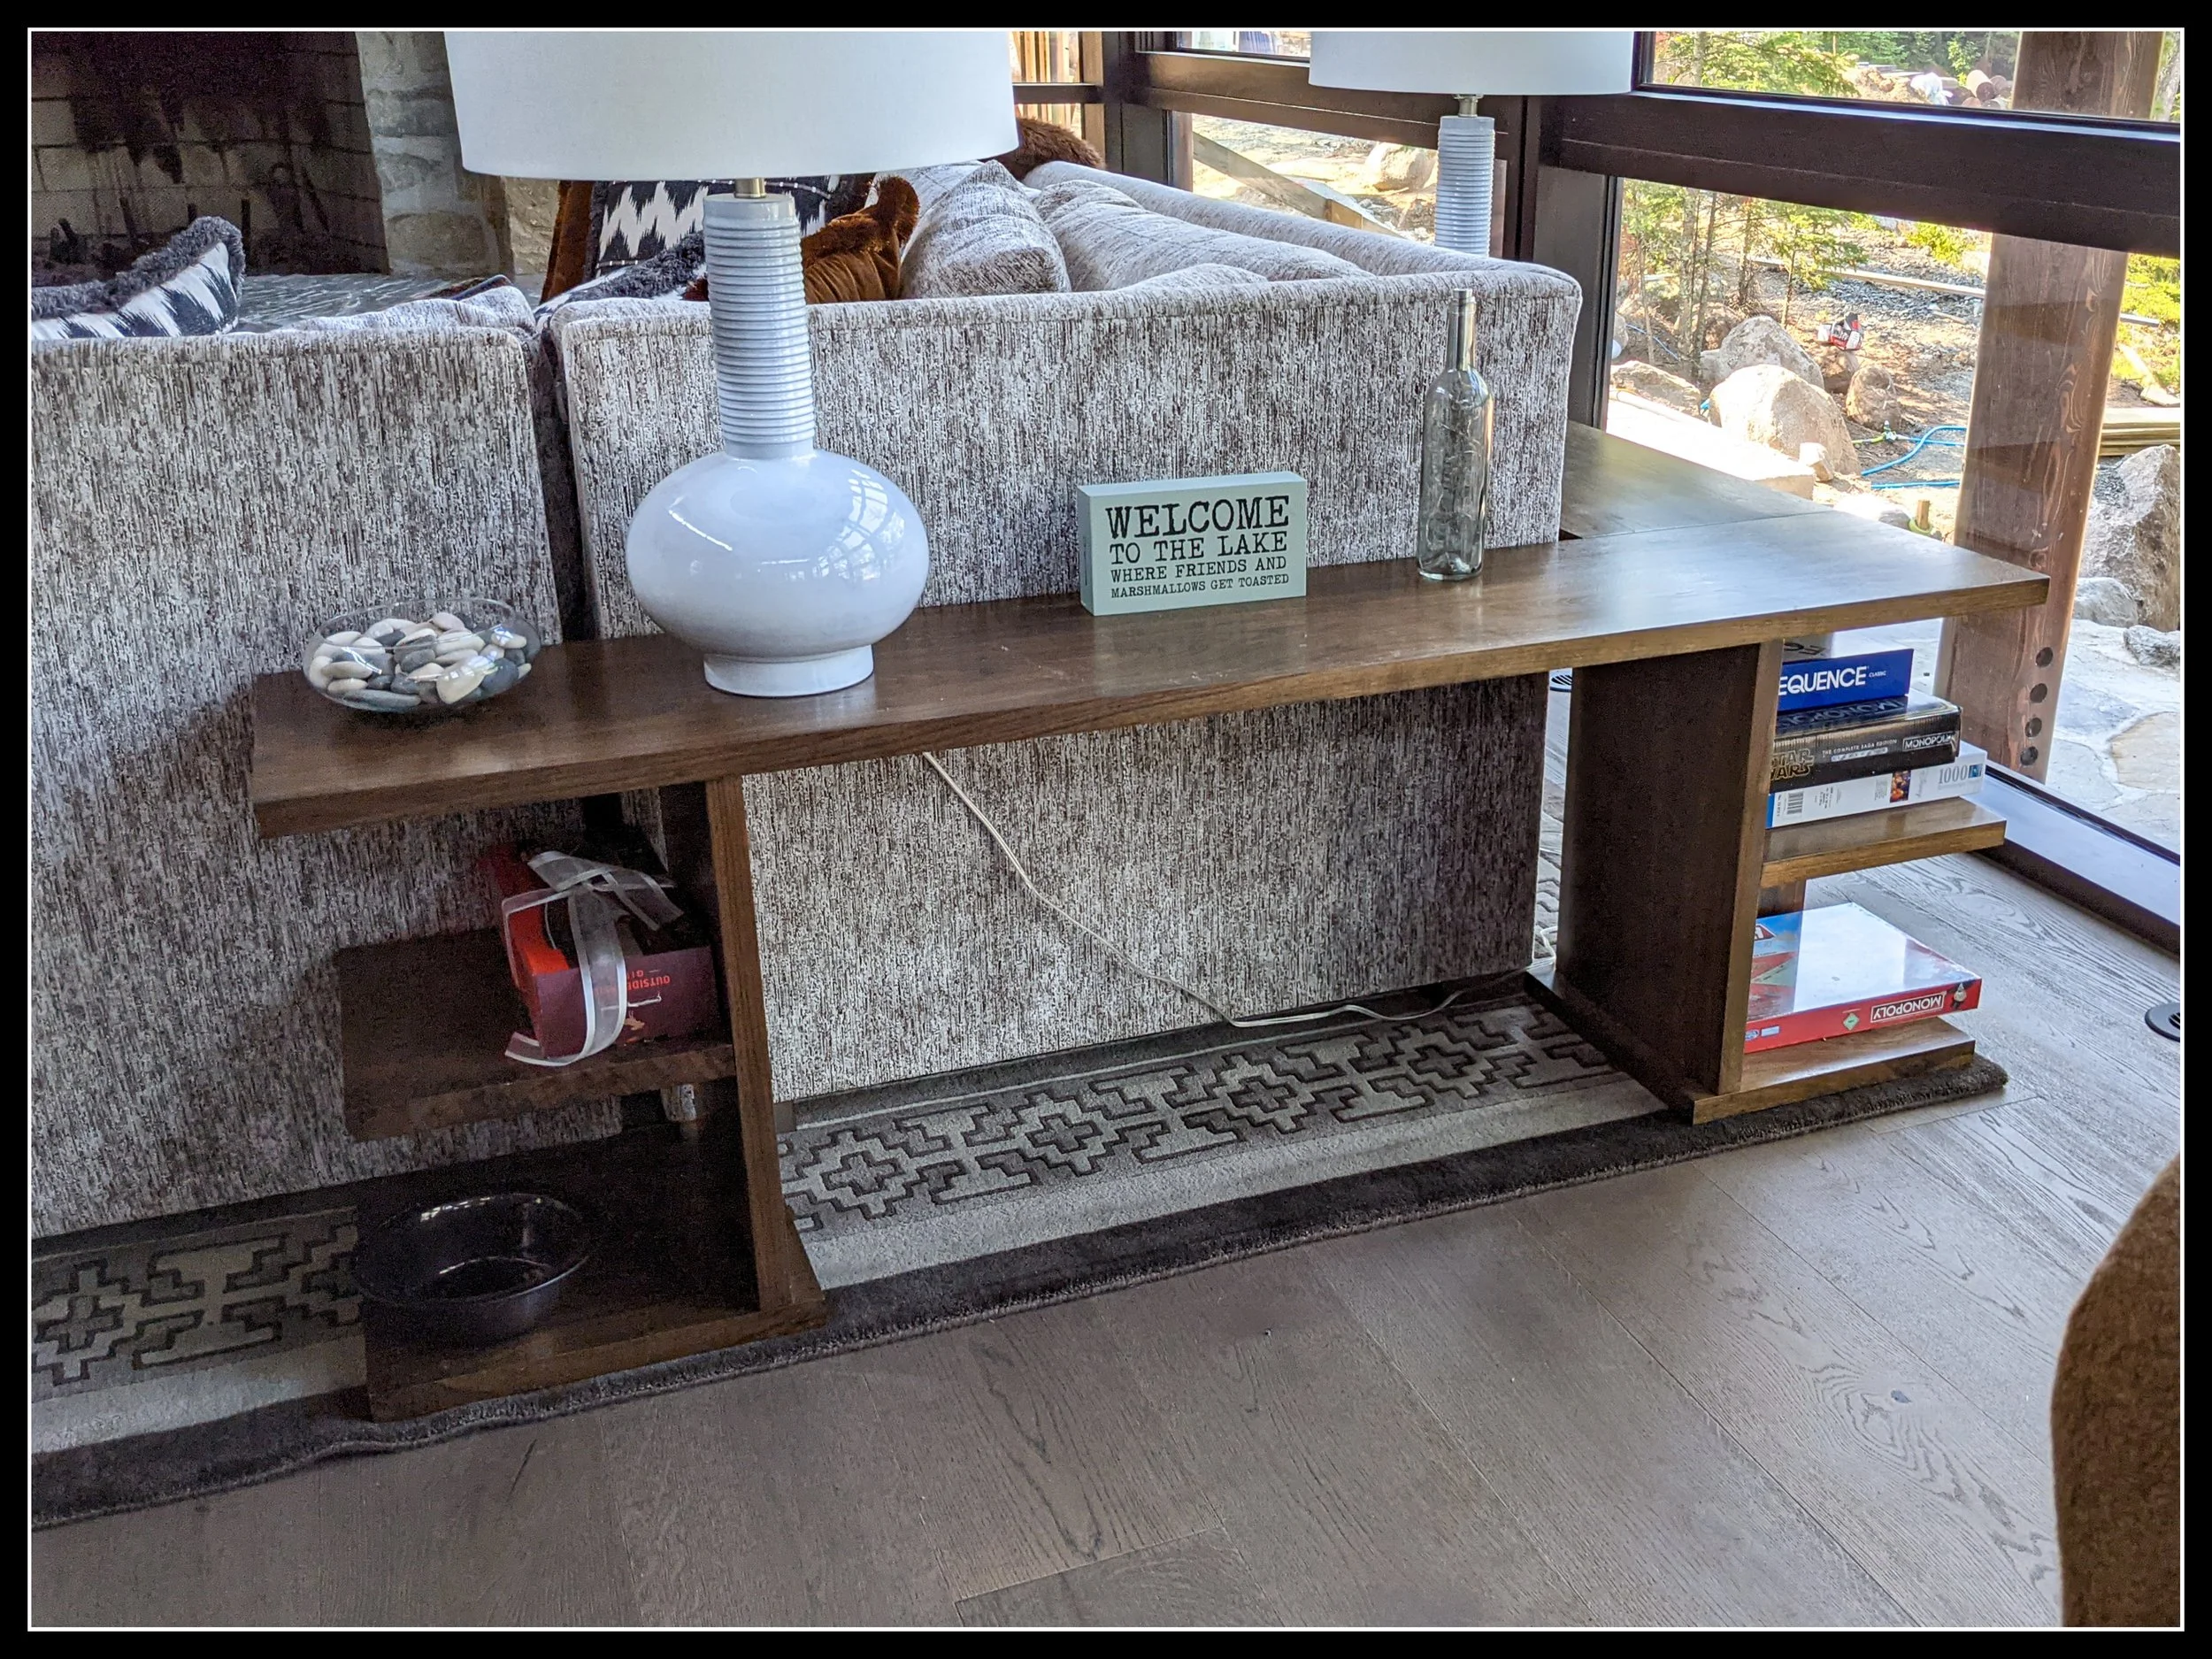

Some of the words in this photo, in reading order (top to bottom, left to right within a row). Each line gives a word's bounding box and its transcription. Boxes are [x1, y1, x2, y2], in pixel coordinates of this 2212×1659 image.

[1105, 495, 1290, 540] WELCOME
[1110, 541, 1141, 565] TO
[1154, 537, 1205, 562] THE
[1217, 531, 1288, 557] LAKE
[1110, 565, 1168, 583] WHERE
[1175, 559, 1247, 579] FRIENDS
[1255, 556, 1286, 572] AND
[1111, 580, 1206, 599] MARSHMALLOWS
[1210, 579, 1233, 590] GET
[1239, 573, 1290, 588] TOASTED
[1778, 665, 1867, 696] EQUENCE
[1833, 744, 1860, 754] COMPLETE
[1861, 741, 1875, 750] SAGA
[1876, 738, 1898, 747] EDITION
[1904, 733, 1952, 750] MONOPOLY
[1939, 764, 1969, 785] 1000
[1873, 994, 1942, 1020] MONOPOLY
